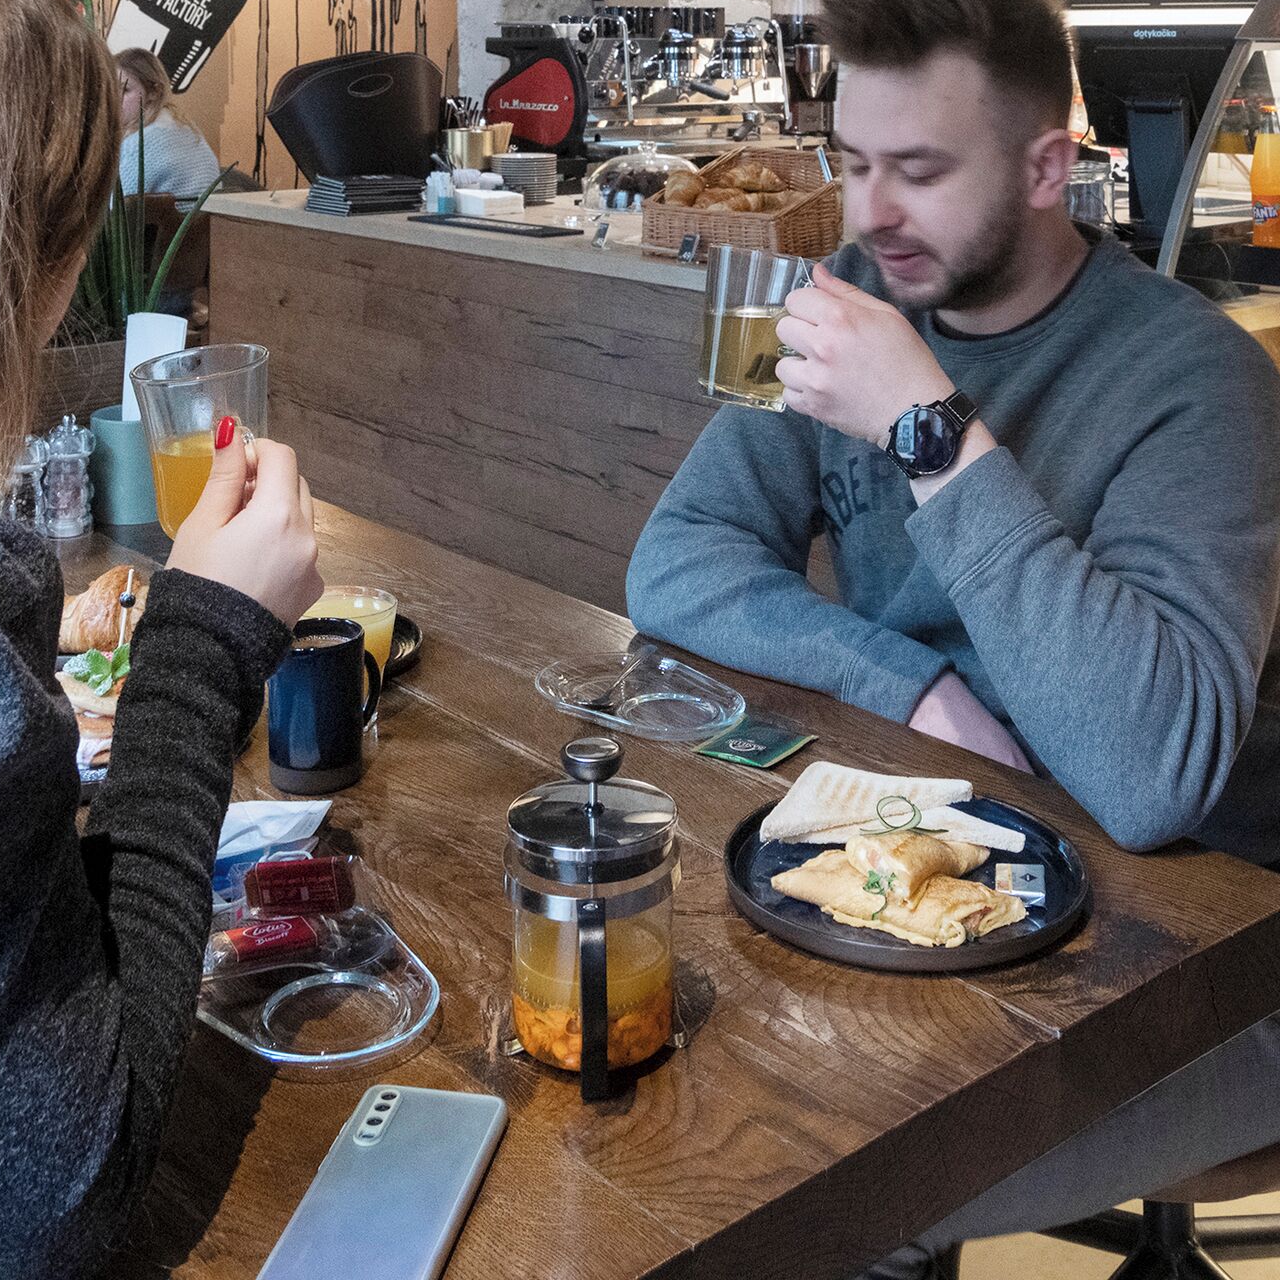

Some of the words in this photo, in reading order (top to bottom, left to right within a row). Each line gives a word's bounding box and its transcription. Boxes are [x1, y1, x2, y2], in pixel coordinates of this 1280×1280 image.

[1133, 29, 1177, 40] dotykačka
[1252, 206, 1278, 221] FANTA
[252, 921, 288, 937] Lotus
[255, 930, 290, 946] Biscoff
